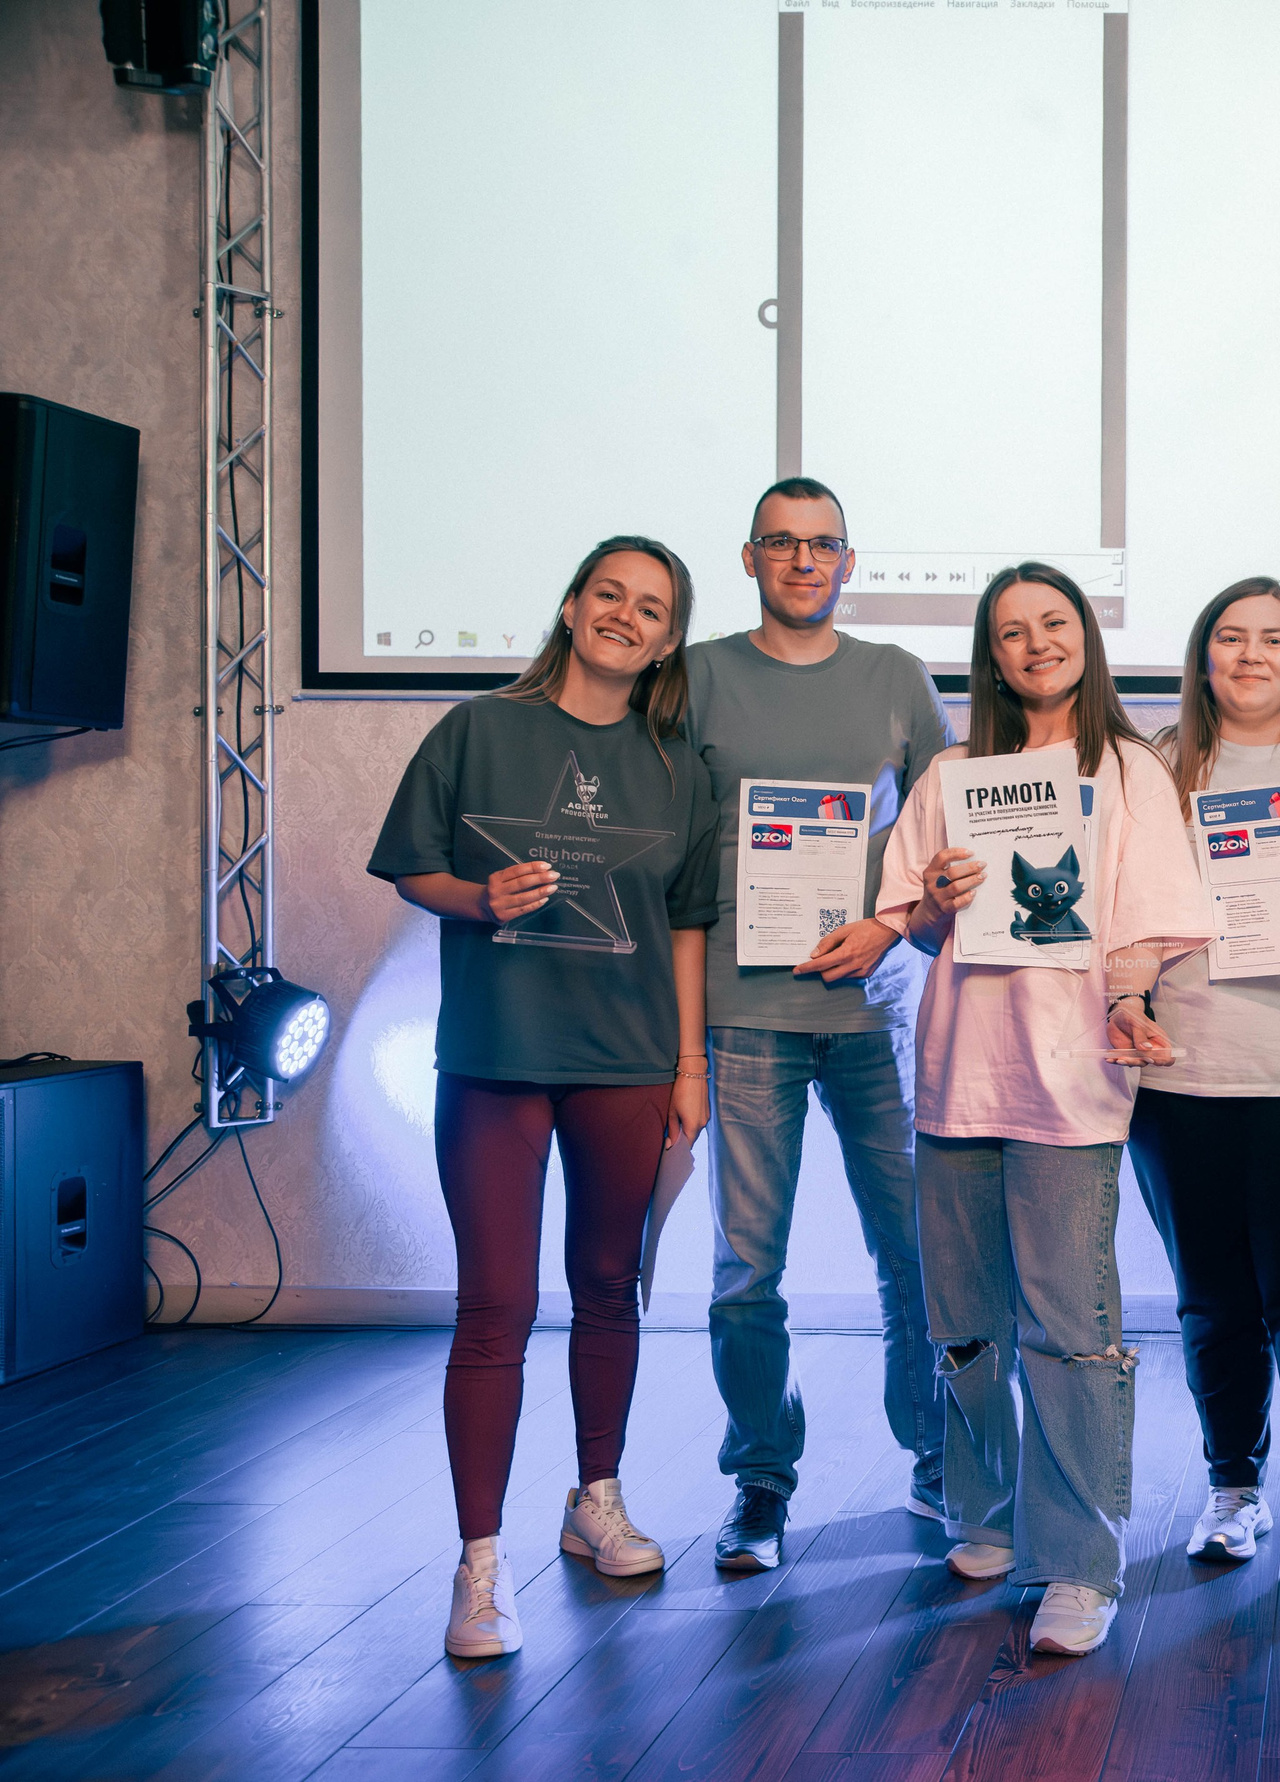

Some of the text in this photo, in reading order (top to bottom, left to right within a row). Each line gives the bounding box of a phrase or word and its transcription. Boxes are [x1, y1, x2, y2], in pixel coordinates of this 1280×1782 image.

[785, 0, 810, 8] Файл
[851, 0, 936, 10] Воспроизведение
[947, 0, 998, 9] Навигация
[1010, 0, 1055, 9] Закладки
[1066, 0, 1110, 9] Помощь
[752, 794, 791, 804] Сертификат
[965, 781, 1057, 810] ГРАМОТА
[567, 802, 604, 811] AGENT
[1202, 802, 1239, 811] Сертификат
[560, 808, 609, 819] PROVOCATEUR
[752, 832, 791, 843] OZON
[1210, 838, 1250, 853] OZON
[528, 846, 606, 864] city home
[1115, 955, 1160, 970] home
